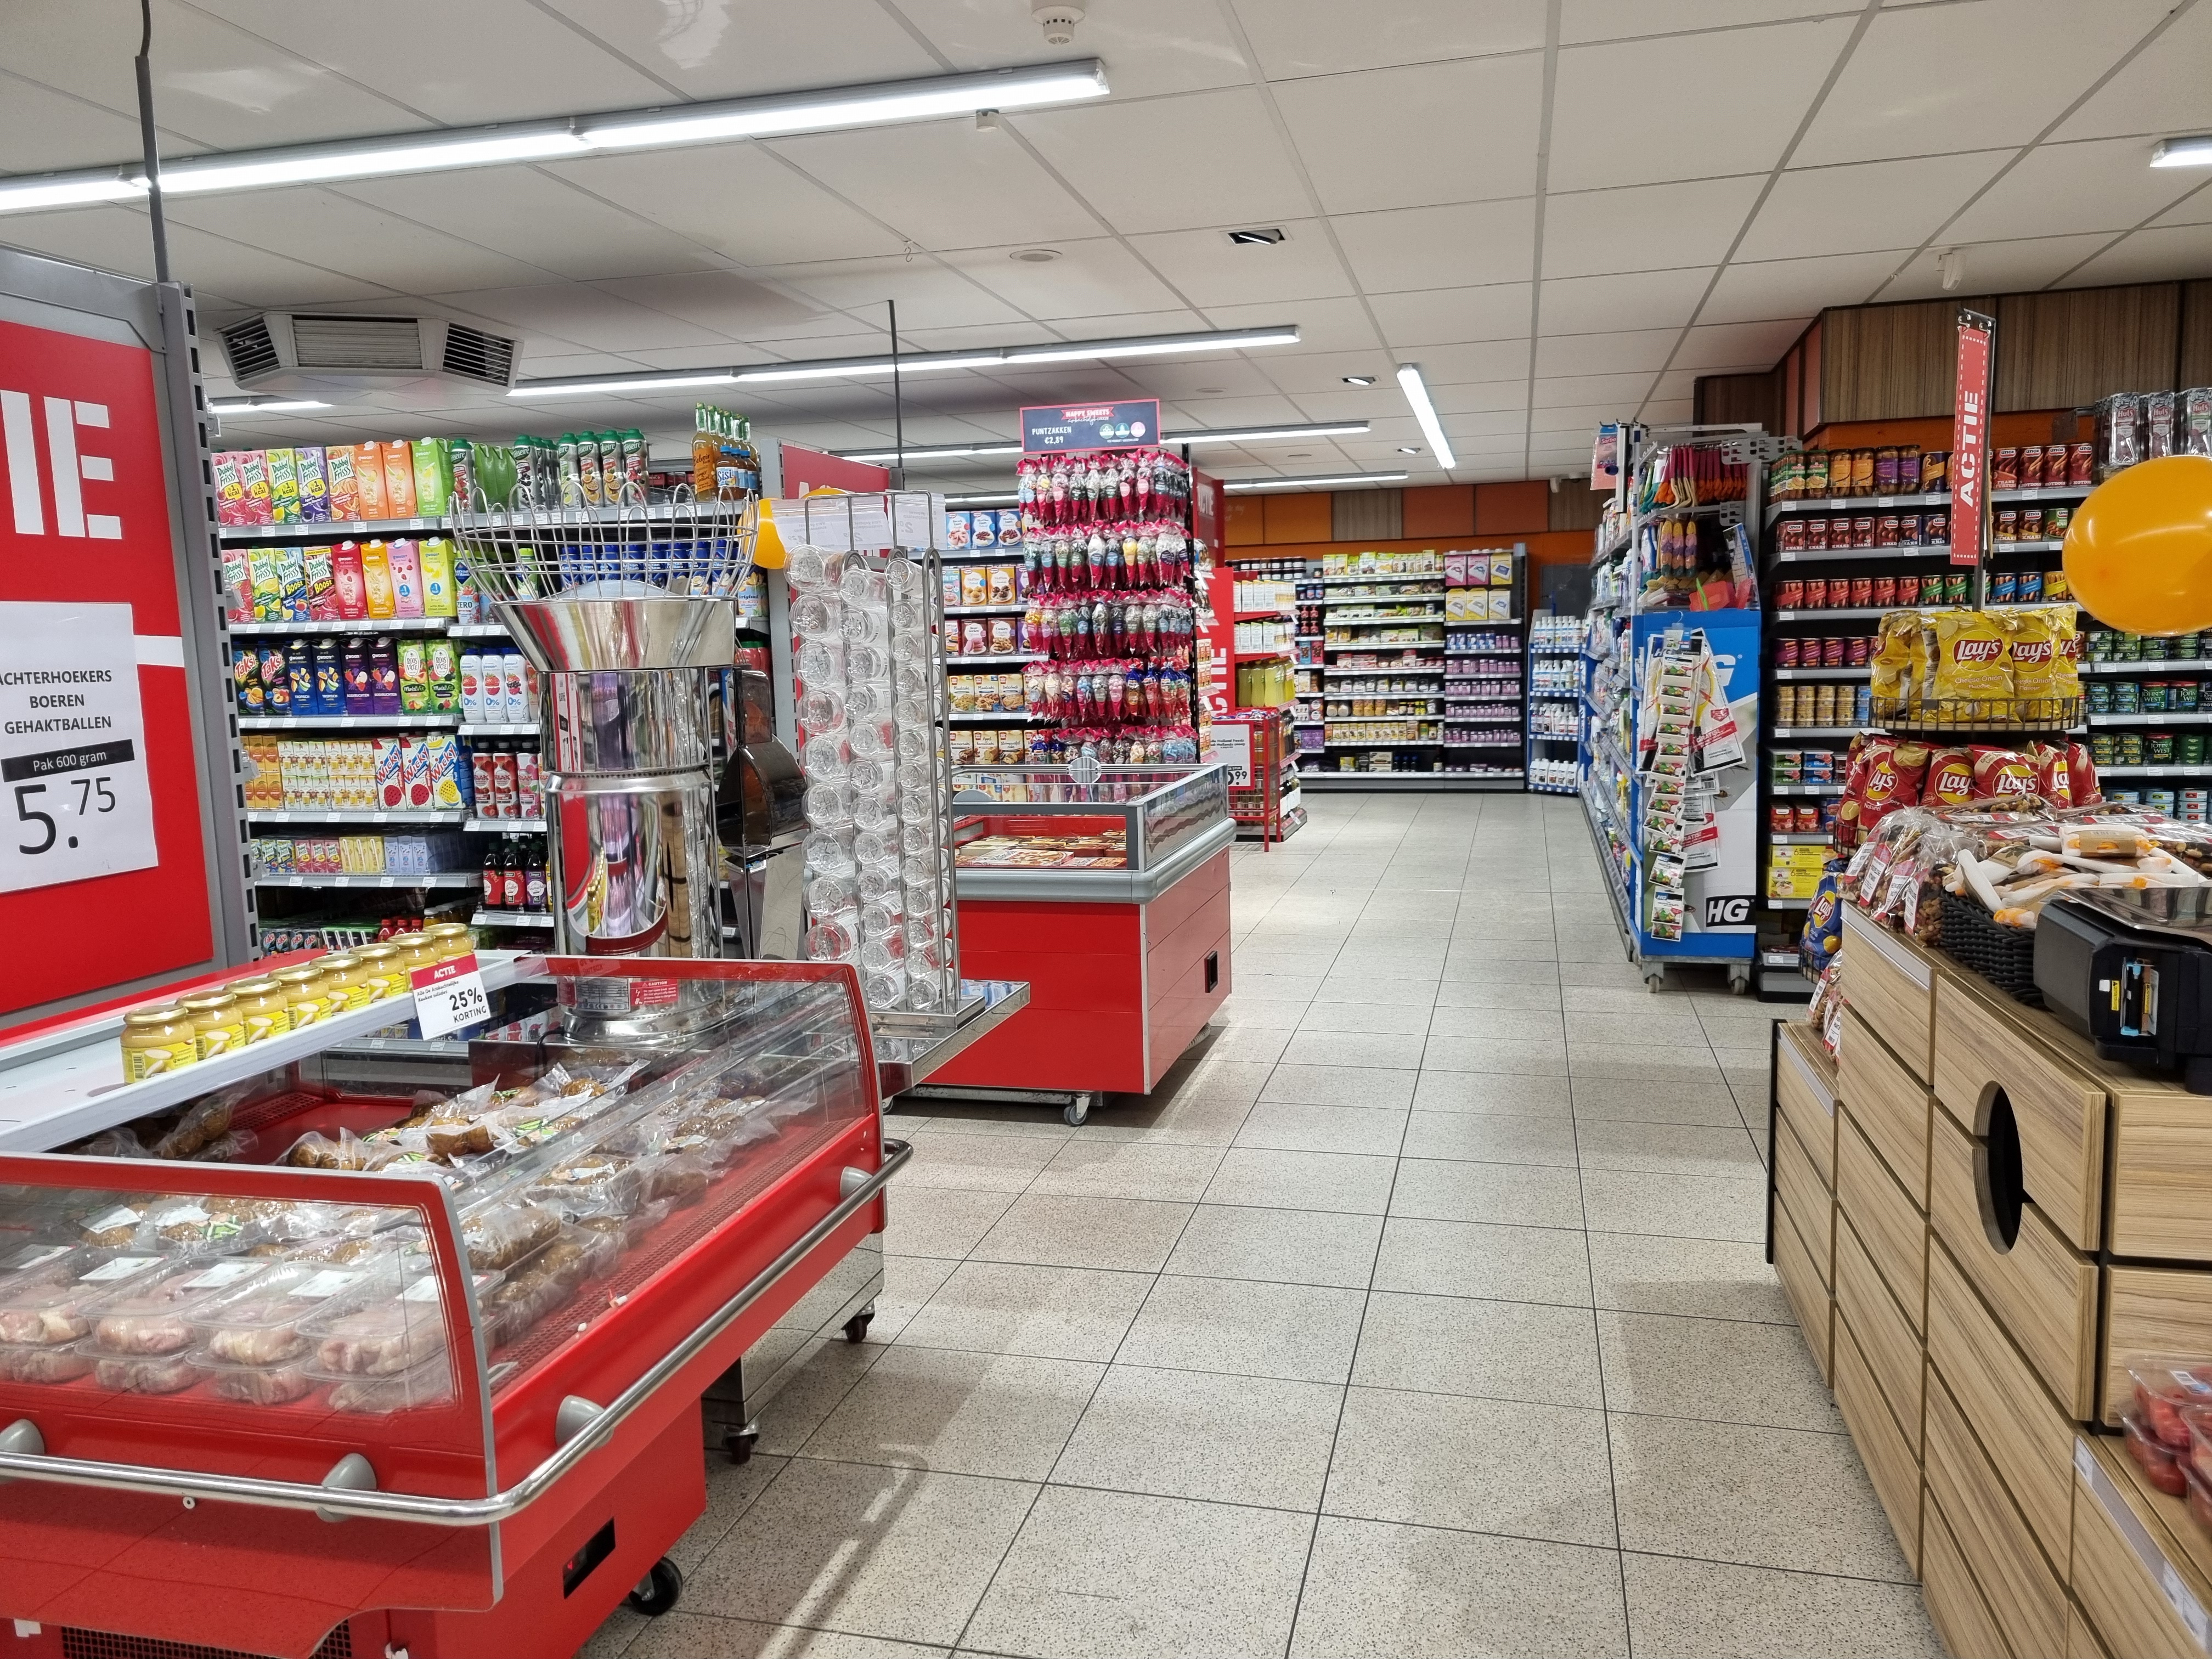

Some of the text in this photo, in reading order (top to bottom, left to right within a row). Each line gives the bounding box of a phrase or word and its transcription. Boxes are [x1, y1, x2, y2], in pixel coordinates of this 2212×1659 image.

[1032, 426, 1071, 435] PUNTZAKKEN
[1960, 391, 1978, 507] ACTIE
[300, 458, 316, 470] Dubbel
[331, 457, 348, 469] Dubbel
[718, 470, 732, 482] Sisi
[253, 560, 268, 572] Dubbel
[280, 560, 295, 572] Dubbel
[307, 560, 324, 572] Dubbel
[286, 580, 303, 594] Boost
[314, 580, 332, 593] Boost
[1956, 639, 2000, 662] Lay's
[235, 654, 256, 679] Taksi
[262, 653, 283, 679] Taksi
[30, 694, 84, 708] BOEREN
[464, 697, 476, 706] 0%
[486, 697, 499, 706] 0%
[4, 716, 111, 734] GEHAKTBALLEN
[33, 752, 106, 771] Pak 600 gram
[376, 748, 402, 783] Wicky
[403, 747, 429, 782] Wicky
[431, 746, 457, 781] Wicky
[1996, 775, 2036, 795] Lay's
[1864, 803, 1881, 812] Naturel
[1707, 899, 1750, 923] HG
[1815, 898, 1833, 919] Lay's
[434, 966, 456, 979] ACTIE
[449, 987, 483, 1011] 25%
[453, 1006, 486, 1023] KORTING
